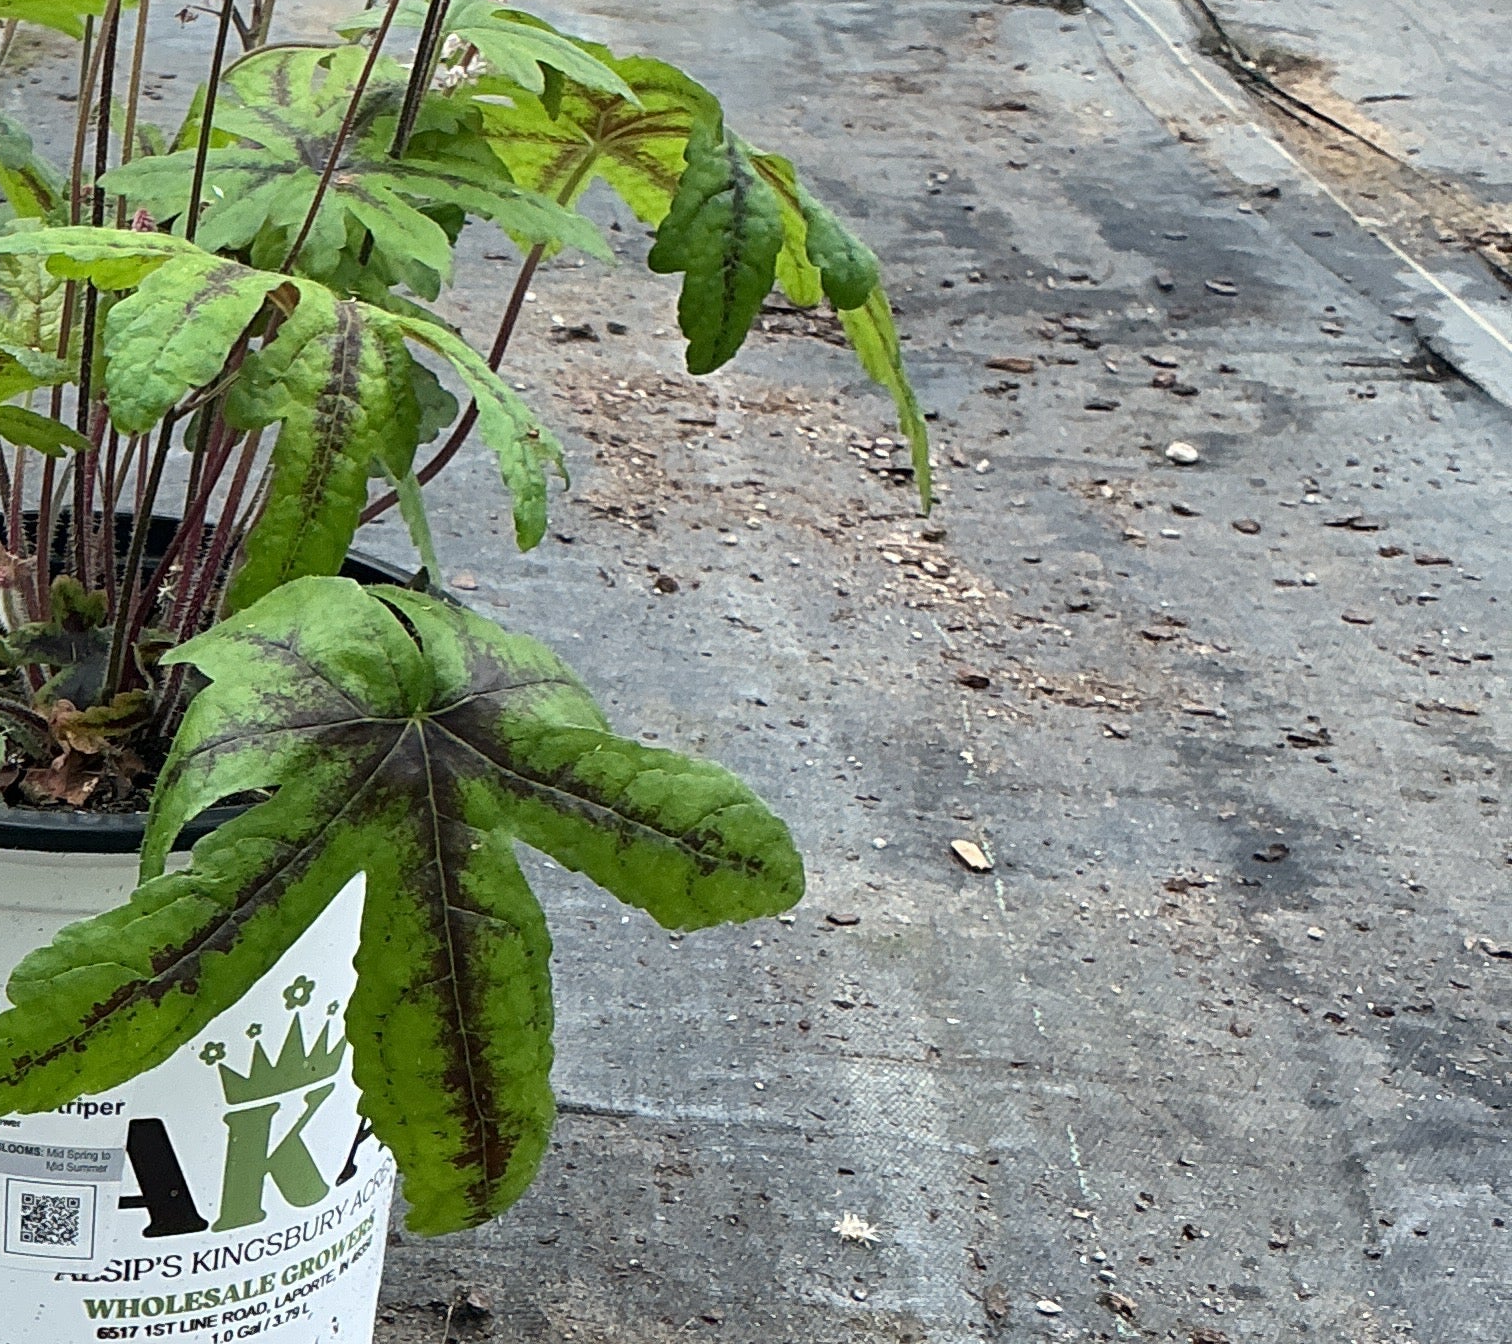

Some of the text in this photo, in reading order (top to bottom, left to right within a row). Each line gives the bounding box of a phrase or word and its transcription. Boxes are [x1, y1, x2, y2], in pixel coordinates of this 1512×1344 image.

[45, 1160, 65, 1172] Mid
[65, 1161, 109, 1173] Summer
[46, 1148, 65, 1159] Mid
[66, 1147, 99, 1162] Spring
[101, 1152, 112, 1161] to
[191, 1198, 350, 1274] KINGSBURY
[83, 1208, 377, 1319] WHOLESALE GROWERS
[96, 1325, 140, 1340] 6517
[144, 1321, 178, 1337] 1ST
[179, 1314, 218, 1333] LINE
[221, 1301, 272, 1325] ROAD,
[274, 1268, 337, 1309] LAPORTE,
[211, 1328, 234, 1344] 1.0
[237, 1320, 262, 1339] Gal
[271, 1308, 300, 1328] 3.79
